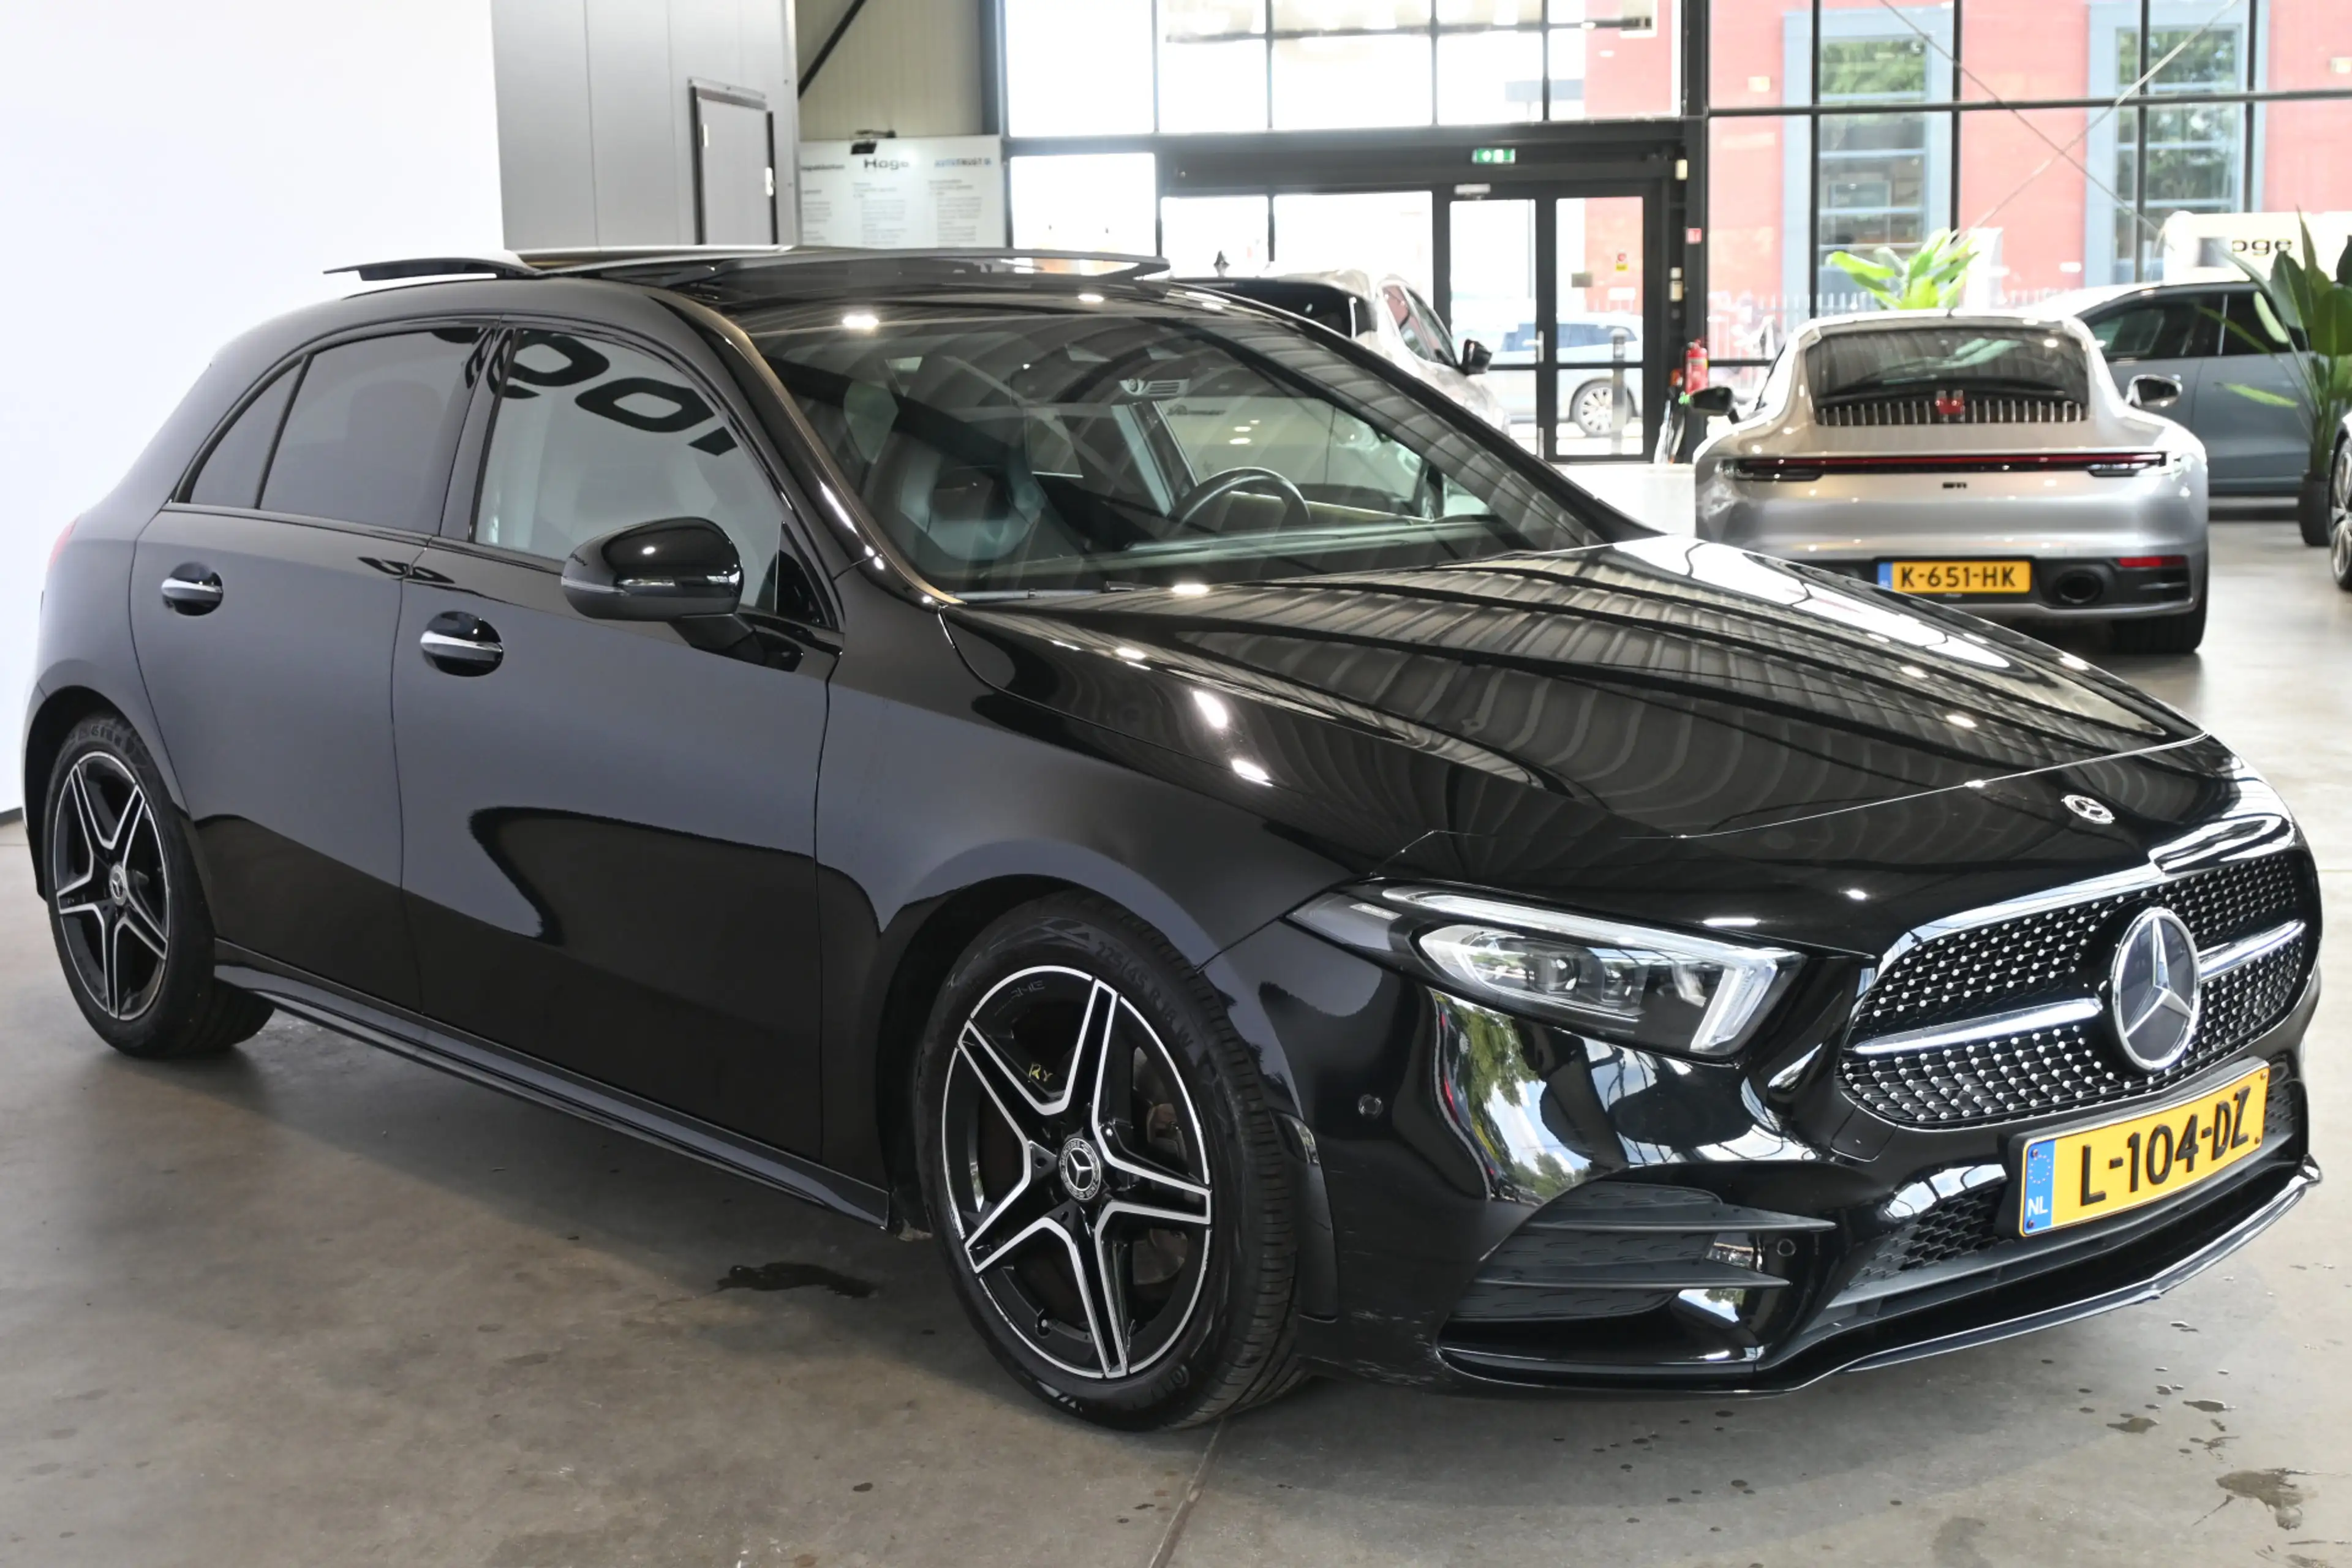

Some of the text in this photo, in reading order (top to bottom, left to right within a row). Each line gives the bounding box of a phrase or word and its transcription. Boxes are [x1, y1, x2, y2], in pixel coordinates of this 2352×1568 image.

[2231, 238, 2293, 255] oge
[1901, 566, 2016, 588] K-651-HK
[2079, 1086, 2252, 1207] L-104-DZ
[2027, 1196, 2049, 1218] NL
